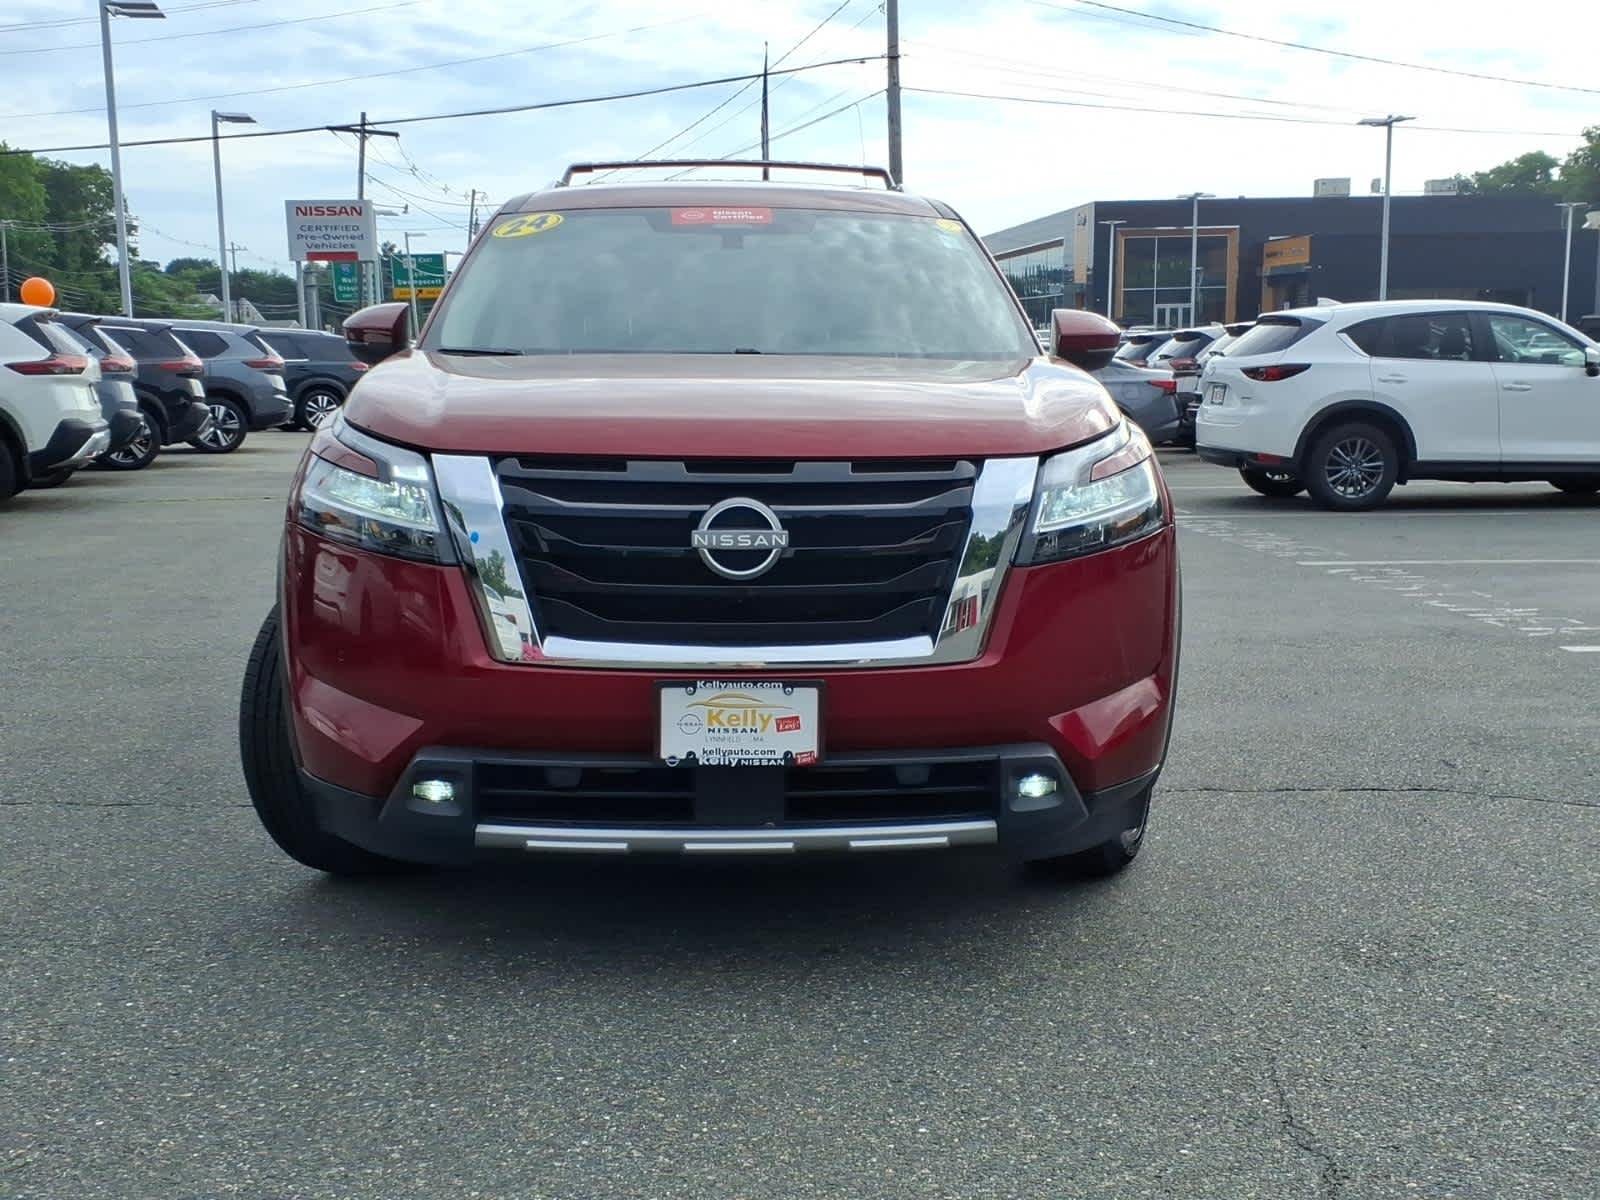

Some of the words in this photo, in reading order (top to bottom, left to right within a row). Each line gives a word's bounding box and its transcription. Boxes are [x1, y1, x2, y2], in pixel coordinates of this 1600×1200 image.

[296, 206, 362, 216] NISSAN
[299, 224, 360, 232] CERTIFIED
[296, 233, 364, 241] Pre-Owned
[694, 534, 786, 546] NISSAN
[697, 680, 783, 691] Kellyauto.com
[707, 709, 773, 733] Kelly
[702, 747, 776, 757] kellyauto.com
[698, 756, 738, 768] Kelly
